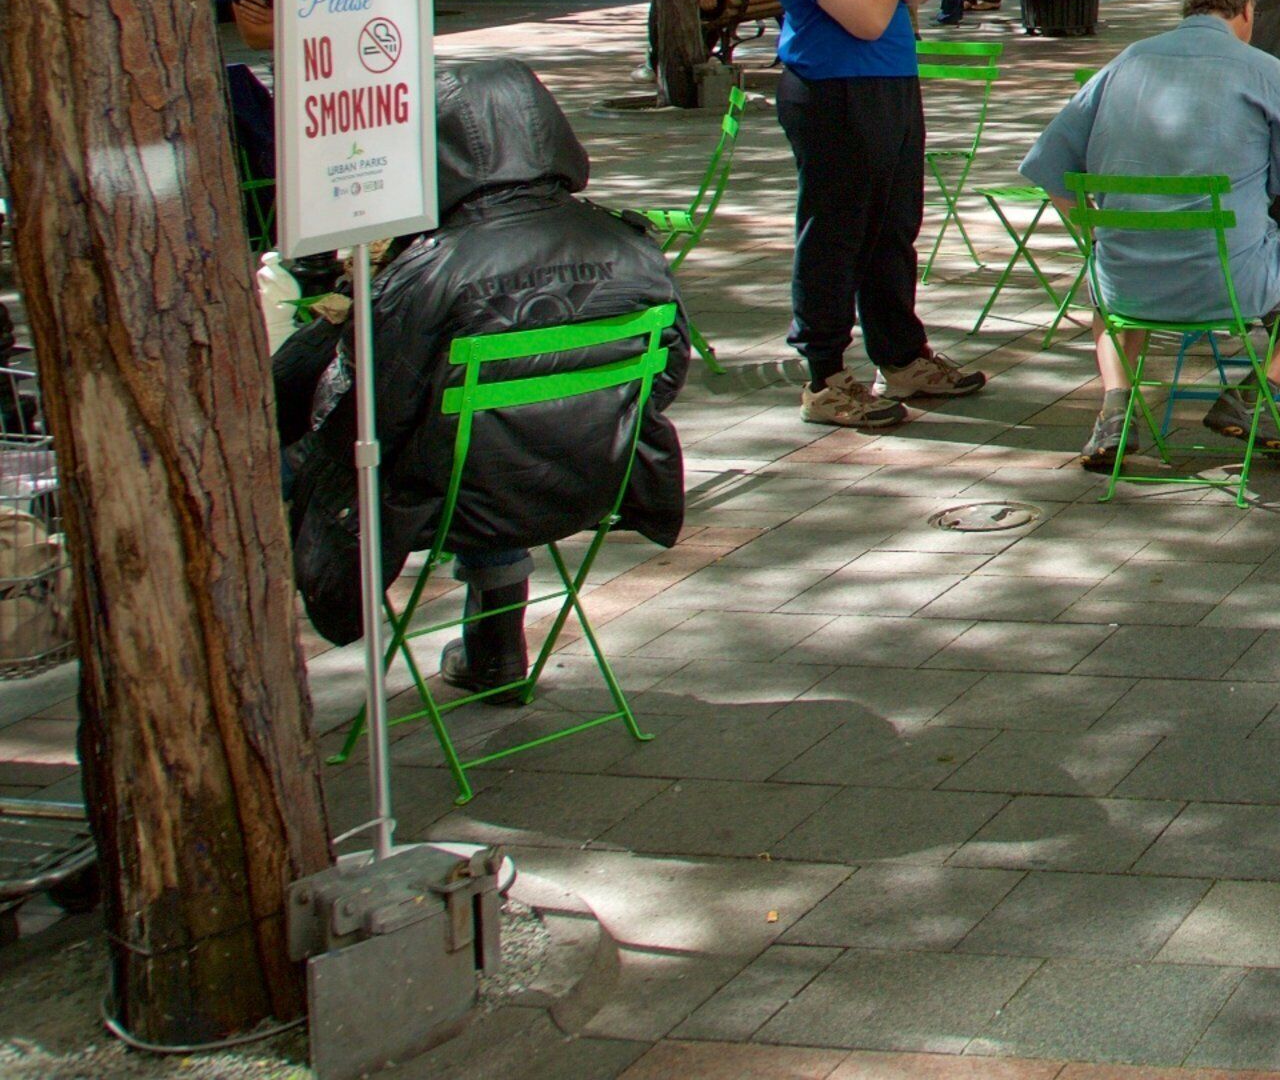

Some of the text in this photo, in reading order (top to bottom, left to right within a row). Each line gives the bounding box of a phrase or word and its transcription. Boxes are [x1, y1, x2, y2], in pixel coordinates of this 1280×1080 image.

[303, 36, 333, 82] NO
[304, 82, 409, 139] SMOKING
[327, 161, 357, 176] URBAN
[360, 156, 388, 168] PARKS
